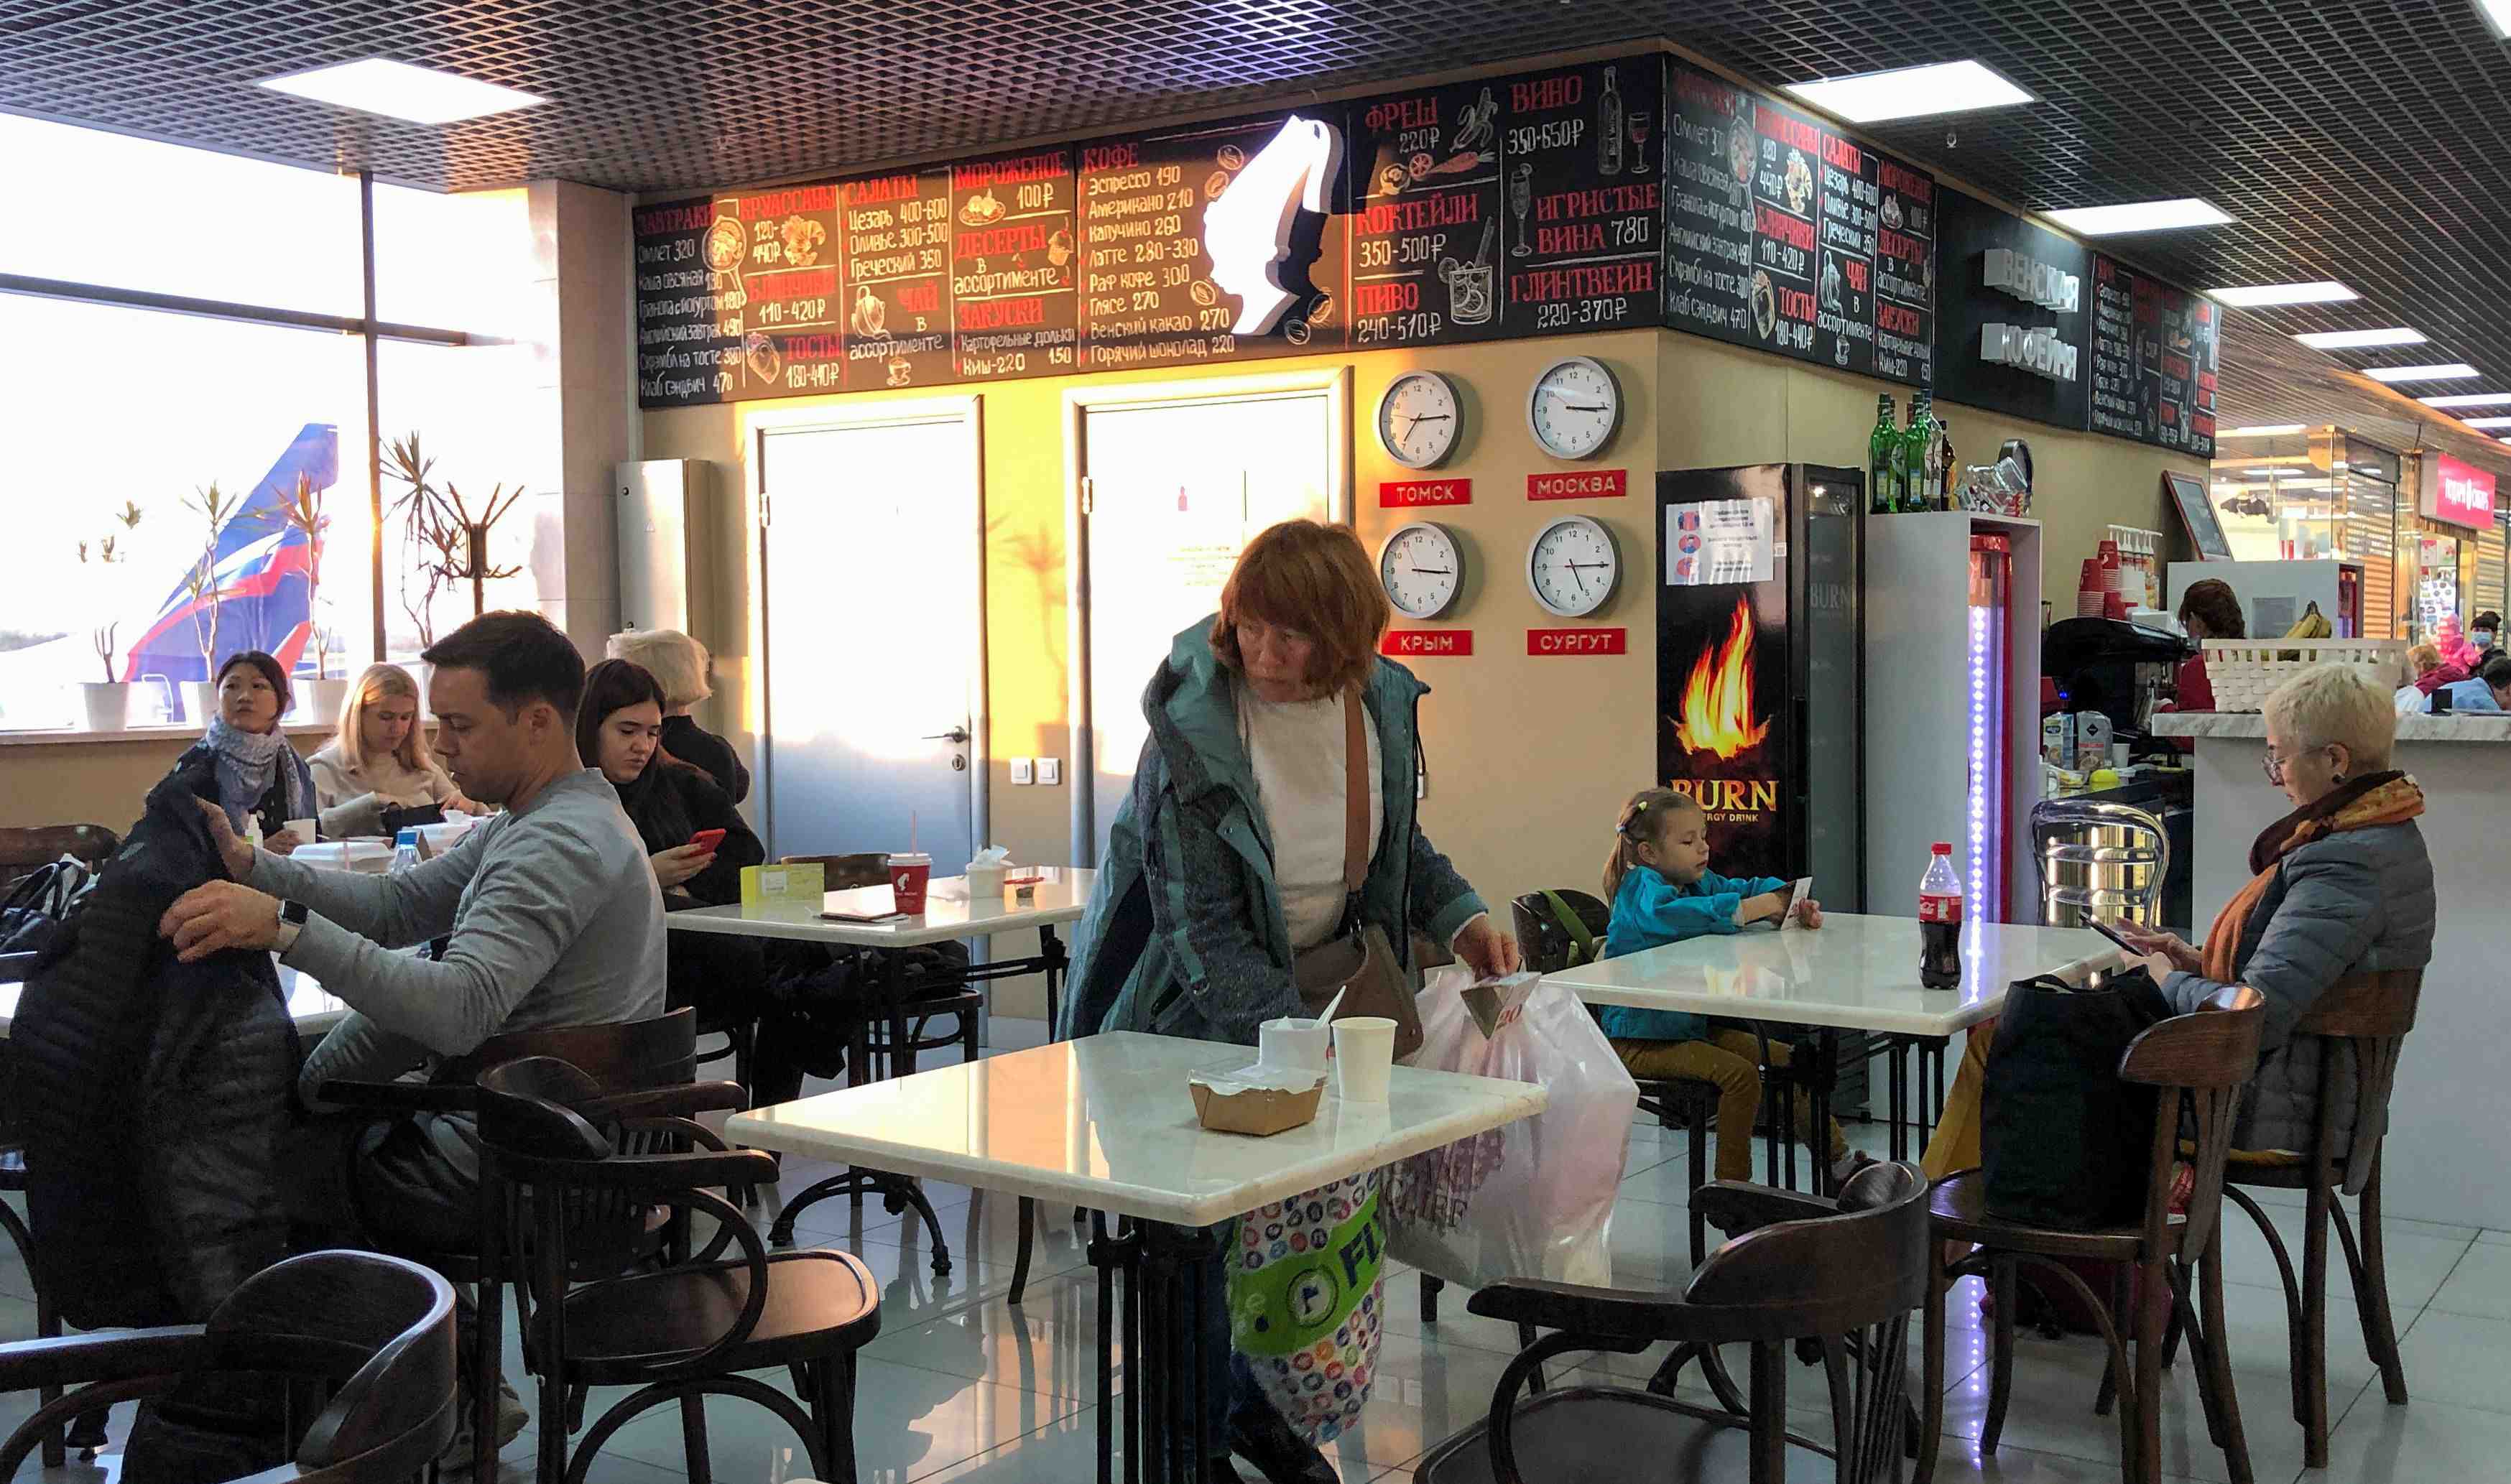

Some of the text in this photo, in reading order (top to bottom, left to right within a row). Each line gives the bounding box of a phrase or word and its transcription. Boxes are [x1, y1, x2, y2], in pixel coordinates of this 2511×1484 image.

[1511, 75, 1582, 113] ВИНО
[1365, 97, 1438, 134] ФРЕШ
[1083, 142, 1139, 175] КОФЕ
[1823, 134, 1861, 175] САЛАТЫ
[954, 151, 1068, 191] МОРОЖЕНОЕ
[1088, 166, 1180, 195] Эспрессо 190
[844, 175, 918, 205] САЛАТЫ
[1088, 188, 1193, 220] Американо 210
[1537, 182, 1659, 222] ИГРИСТЫЕ
[848, 209, 893, 233] Цезарь
[1356, 191, 1478, 236] КОКТЕЙЛИ
[850, 231, 896, 255] Оливье
[954, 224, 1047, 264] ДЕСЕРТЫ
[1088, 215, 1180, 243] Капучино 260
[1537, 217, 1649, 255] ВИНА 780
[673, 238, 695, 261] 320
[1089, 247, 1128, 269] Латте
[851, 249, 942, 282] Греческий 350
[1090, 264, 1189, 293] Раф кофе 300
[954, 266, 1059, 296] ассортименте
[1510, 261, 1654, 304] ГЛИНТВЕЙН
[958, 297, 1044, 329] ЗАКУСКИ
[1090, 292, 1160, 317] Глясе 270
[1356, 282, 1420, 315] ПИВО
[1779, 286, 1816, 323] ТОСТЫ
[1091, 308, 1229, 340] Венский какао 270
[1731, 307, 1747, 329] 470
[1817, 310, 1872, 342] ассортименте
[783, 333, 841, 361] ТОСТЫ
[849, 335, 943, 363] ассортименте
[961, 328, 1075, 354] Картофельные дольки
[1048, 347, 1071, 365] 150
[1091, 335, 1234, 367] Горячий шоколад 220
[1981, 323, 2078, 382] КОФЕЙНЯ
[693, 350, 721, 366] тосте
[713, 372, 733, 394] 470
[1396, 485, 1456, 501] ТОМСК
[1537, 476, 1616, 494] МОСКВА
[1810, 584, 1853, 609] BURN
[1400, 635, 1453, 651] КРЫМ
[1540, 634, 1612, 651] СУРГУТ
